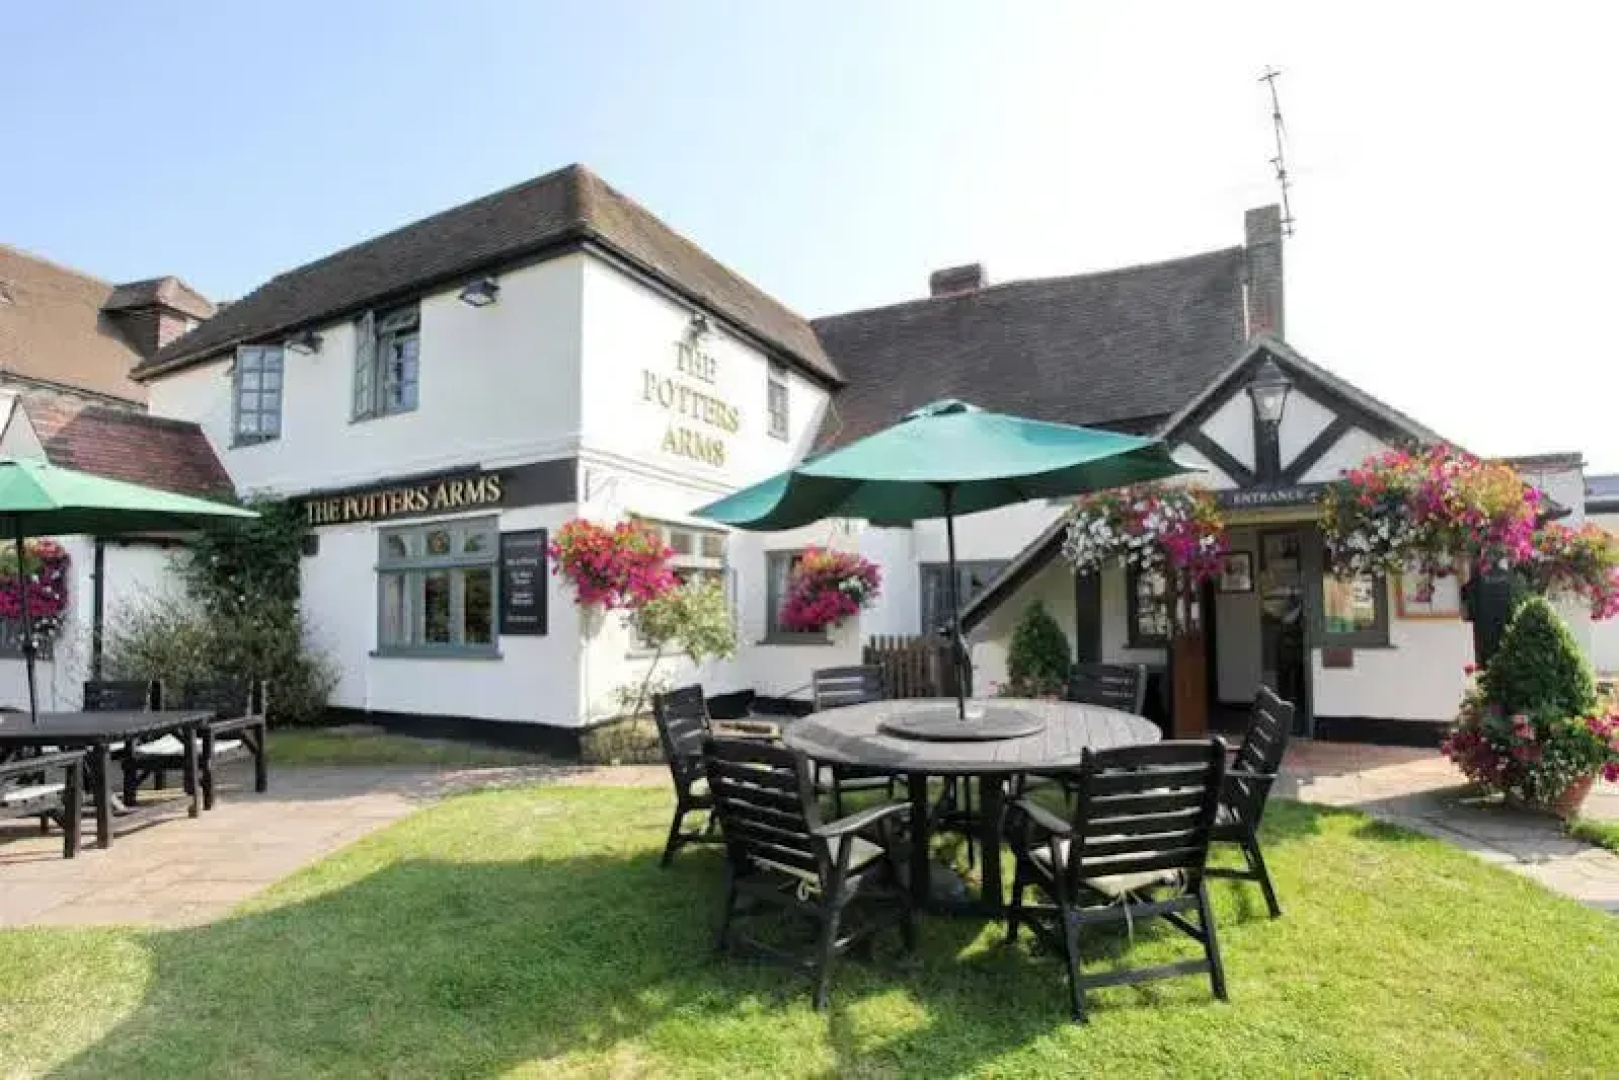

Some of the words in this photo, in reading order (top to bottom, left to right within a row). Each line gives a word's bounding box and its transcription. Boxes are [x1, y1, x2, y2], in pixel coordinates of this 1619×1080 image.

[673, 340, 716, 385] THE
[641, 368, 739, 434] POTTERS
[662, 427, 725, 467] ARMS
[307, 499, 341, 524] THE
[343, 485, 429, 519] POTTERS
[433, 475, 501, 509] ARMS
[1233, 490, 1304, 504] ENTRANCE
